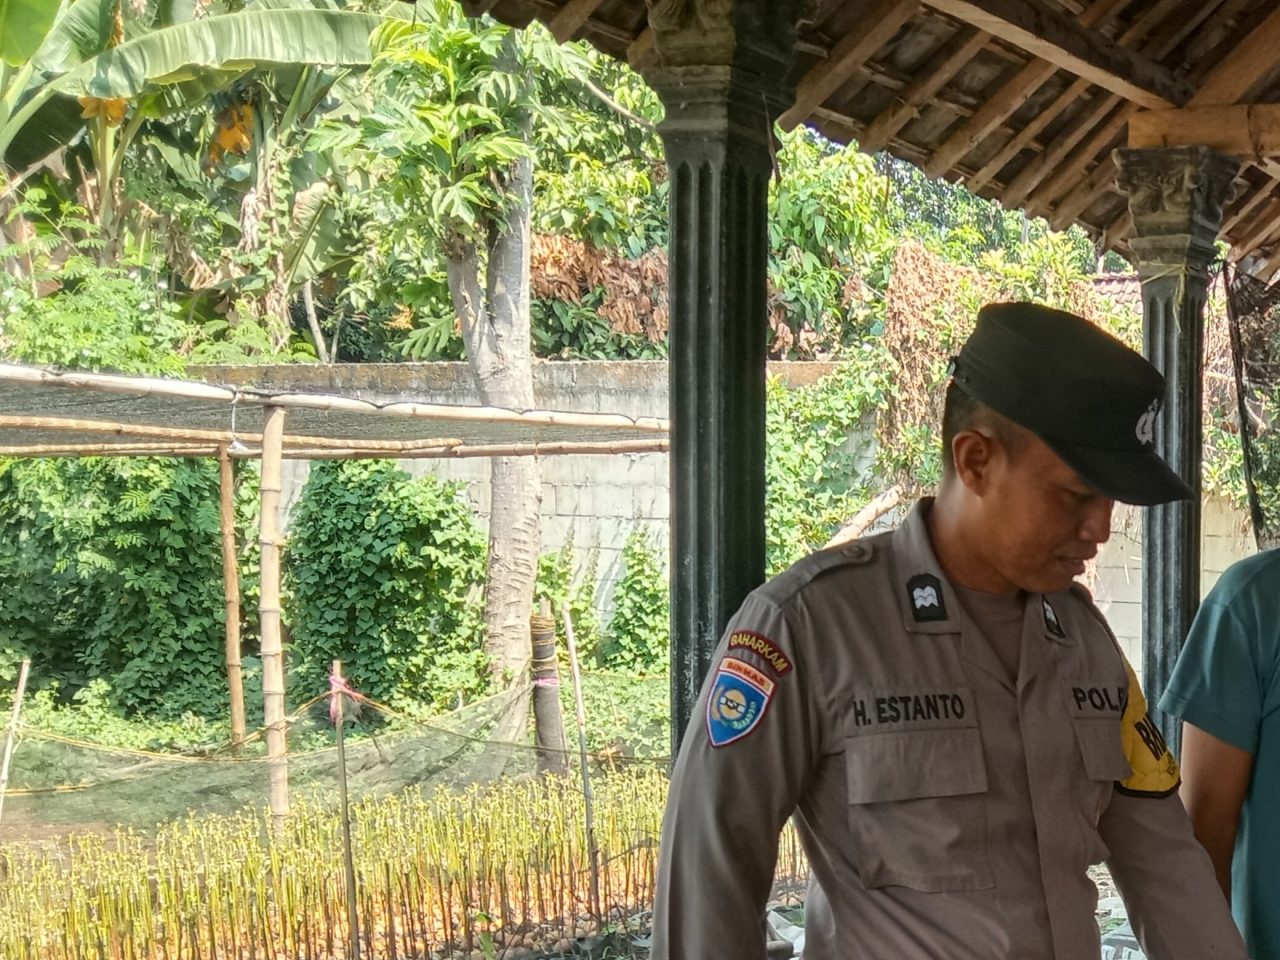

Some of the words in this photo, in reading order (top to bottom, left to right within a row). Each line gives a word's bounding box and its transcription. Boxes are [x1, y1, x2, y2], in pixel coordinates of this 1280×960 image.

[731, 633, 788, 673] BAHARKAM
[853, 700, 872, 726] H.
[876, 694, 965, 724] ESTANTO
